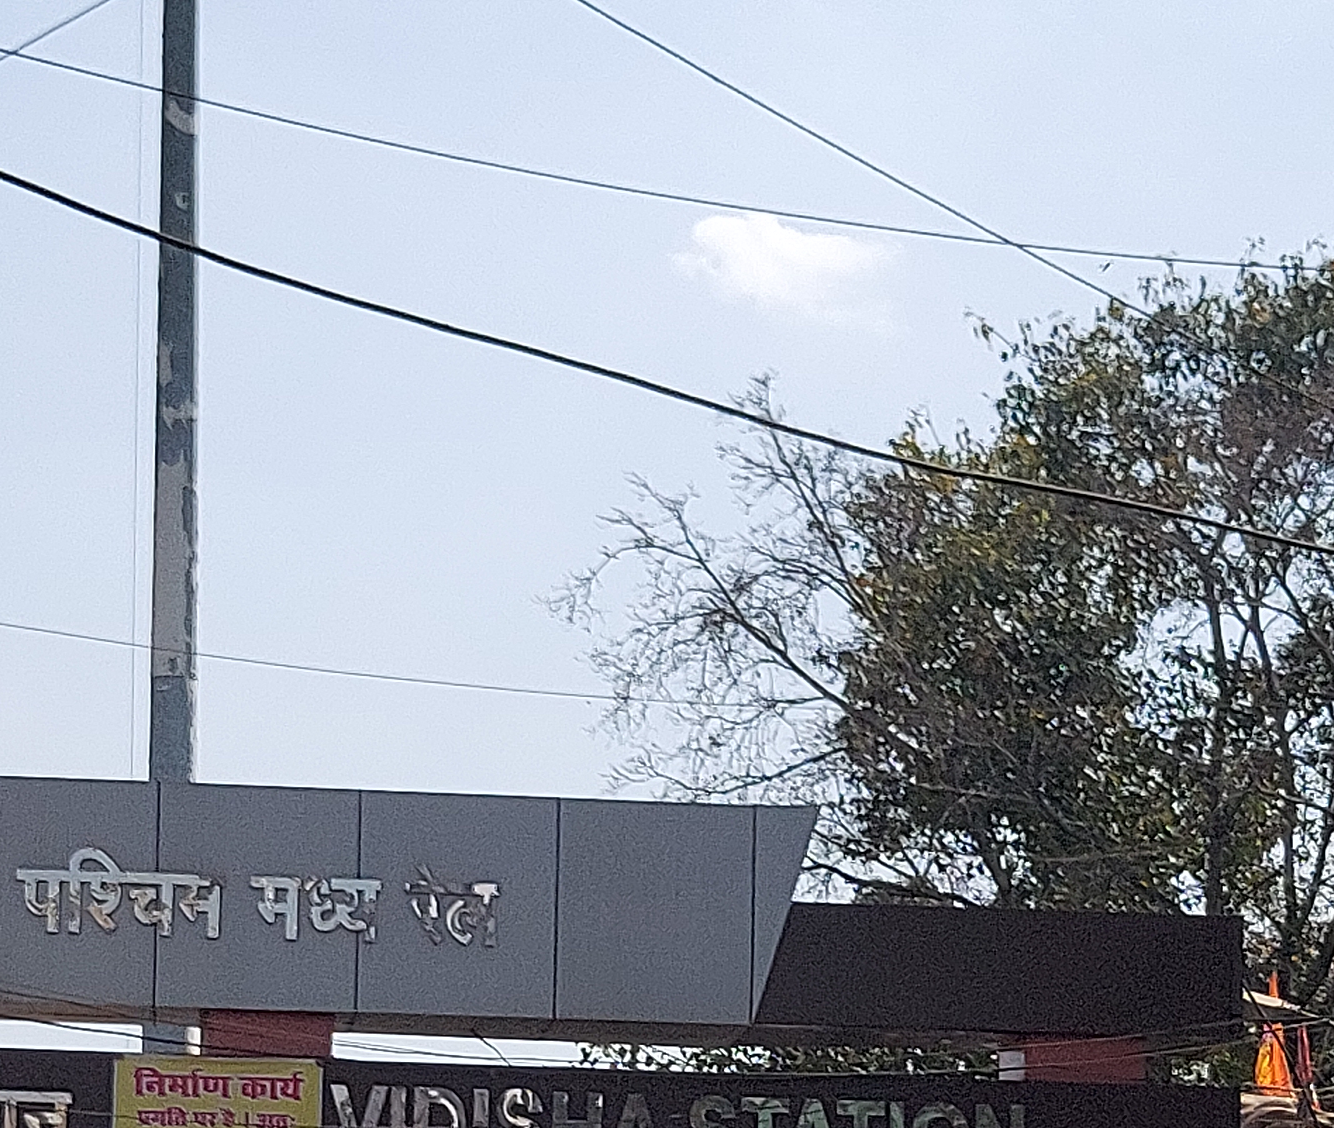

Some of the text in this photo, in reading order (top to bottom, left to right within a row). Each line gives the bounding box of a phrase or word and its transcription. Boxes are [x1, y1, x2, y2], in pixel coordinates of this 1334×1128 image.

[17, 846, 222, 939] पश्चिम
[249, 875, 383, 942] मध्य
[134, 1067, 304, 1100] निर्माण कार्य
